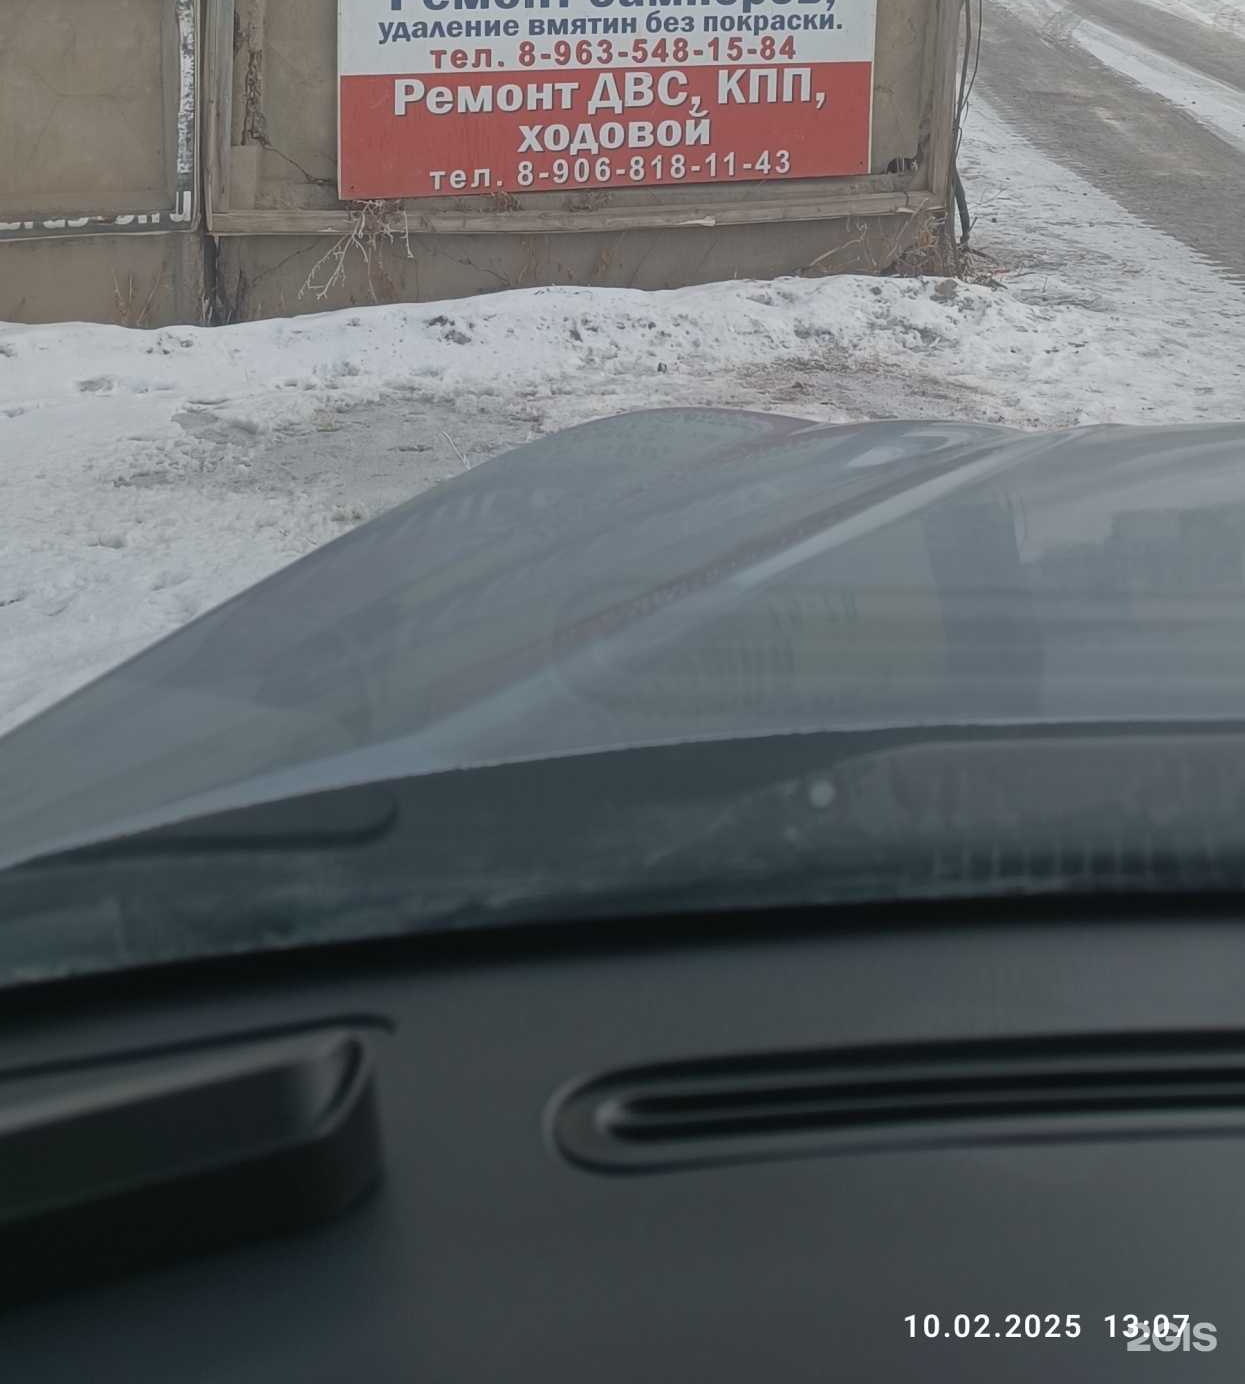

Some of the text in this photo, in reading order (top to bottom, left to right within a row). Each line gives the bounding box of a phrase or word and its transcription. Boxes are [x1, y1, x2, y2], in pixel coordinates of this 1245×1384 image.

[378, 12, 844, 44] удаление вмятин без покраски.
[430, 35, 797, 70] тел. 8-963-548-15-84
[393, 67, 827, 116] Ремонт ДВС, КПП,
[517, 108, 712, 155] ходовой
[429, 150, 792, 191] тел. 8-906-818-11-43
